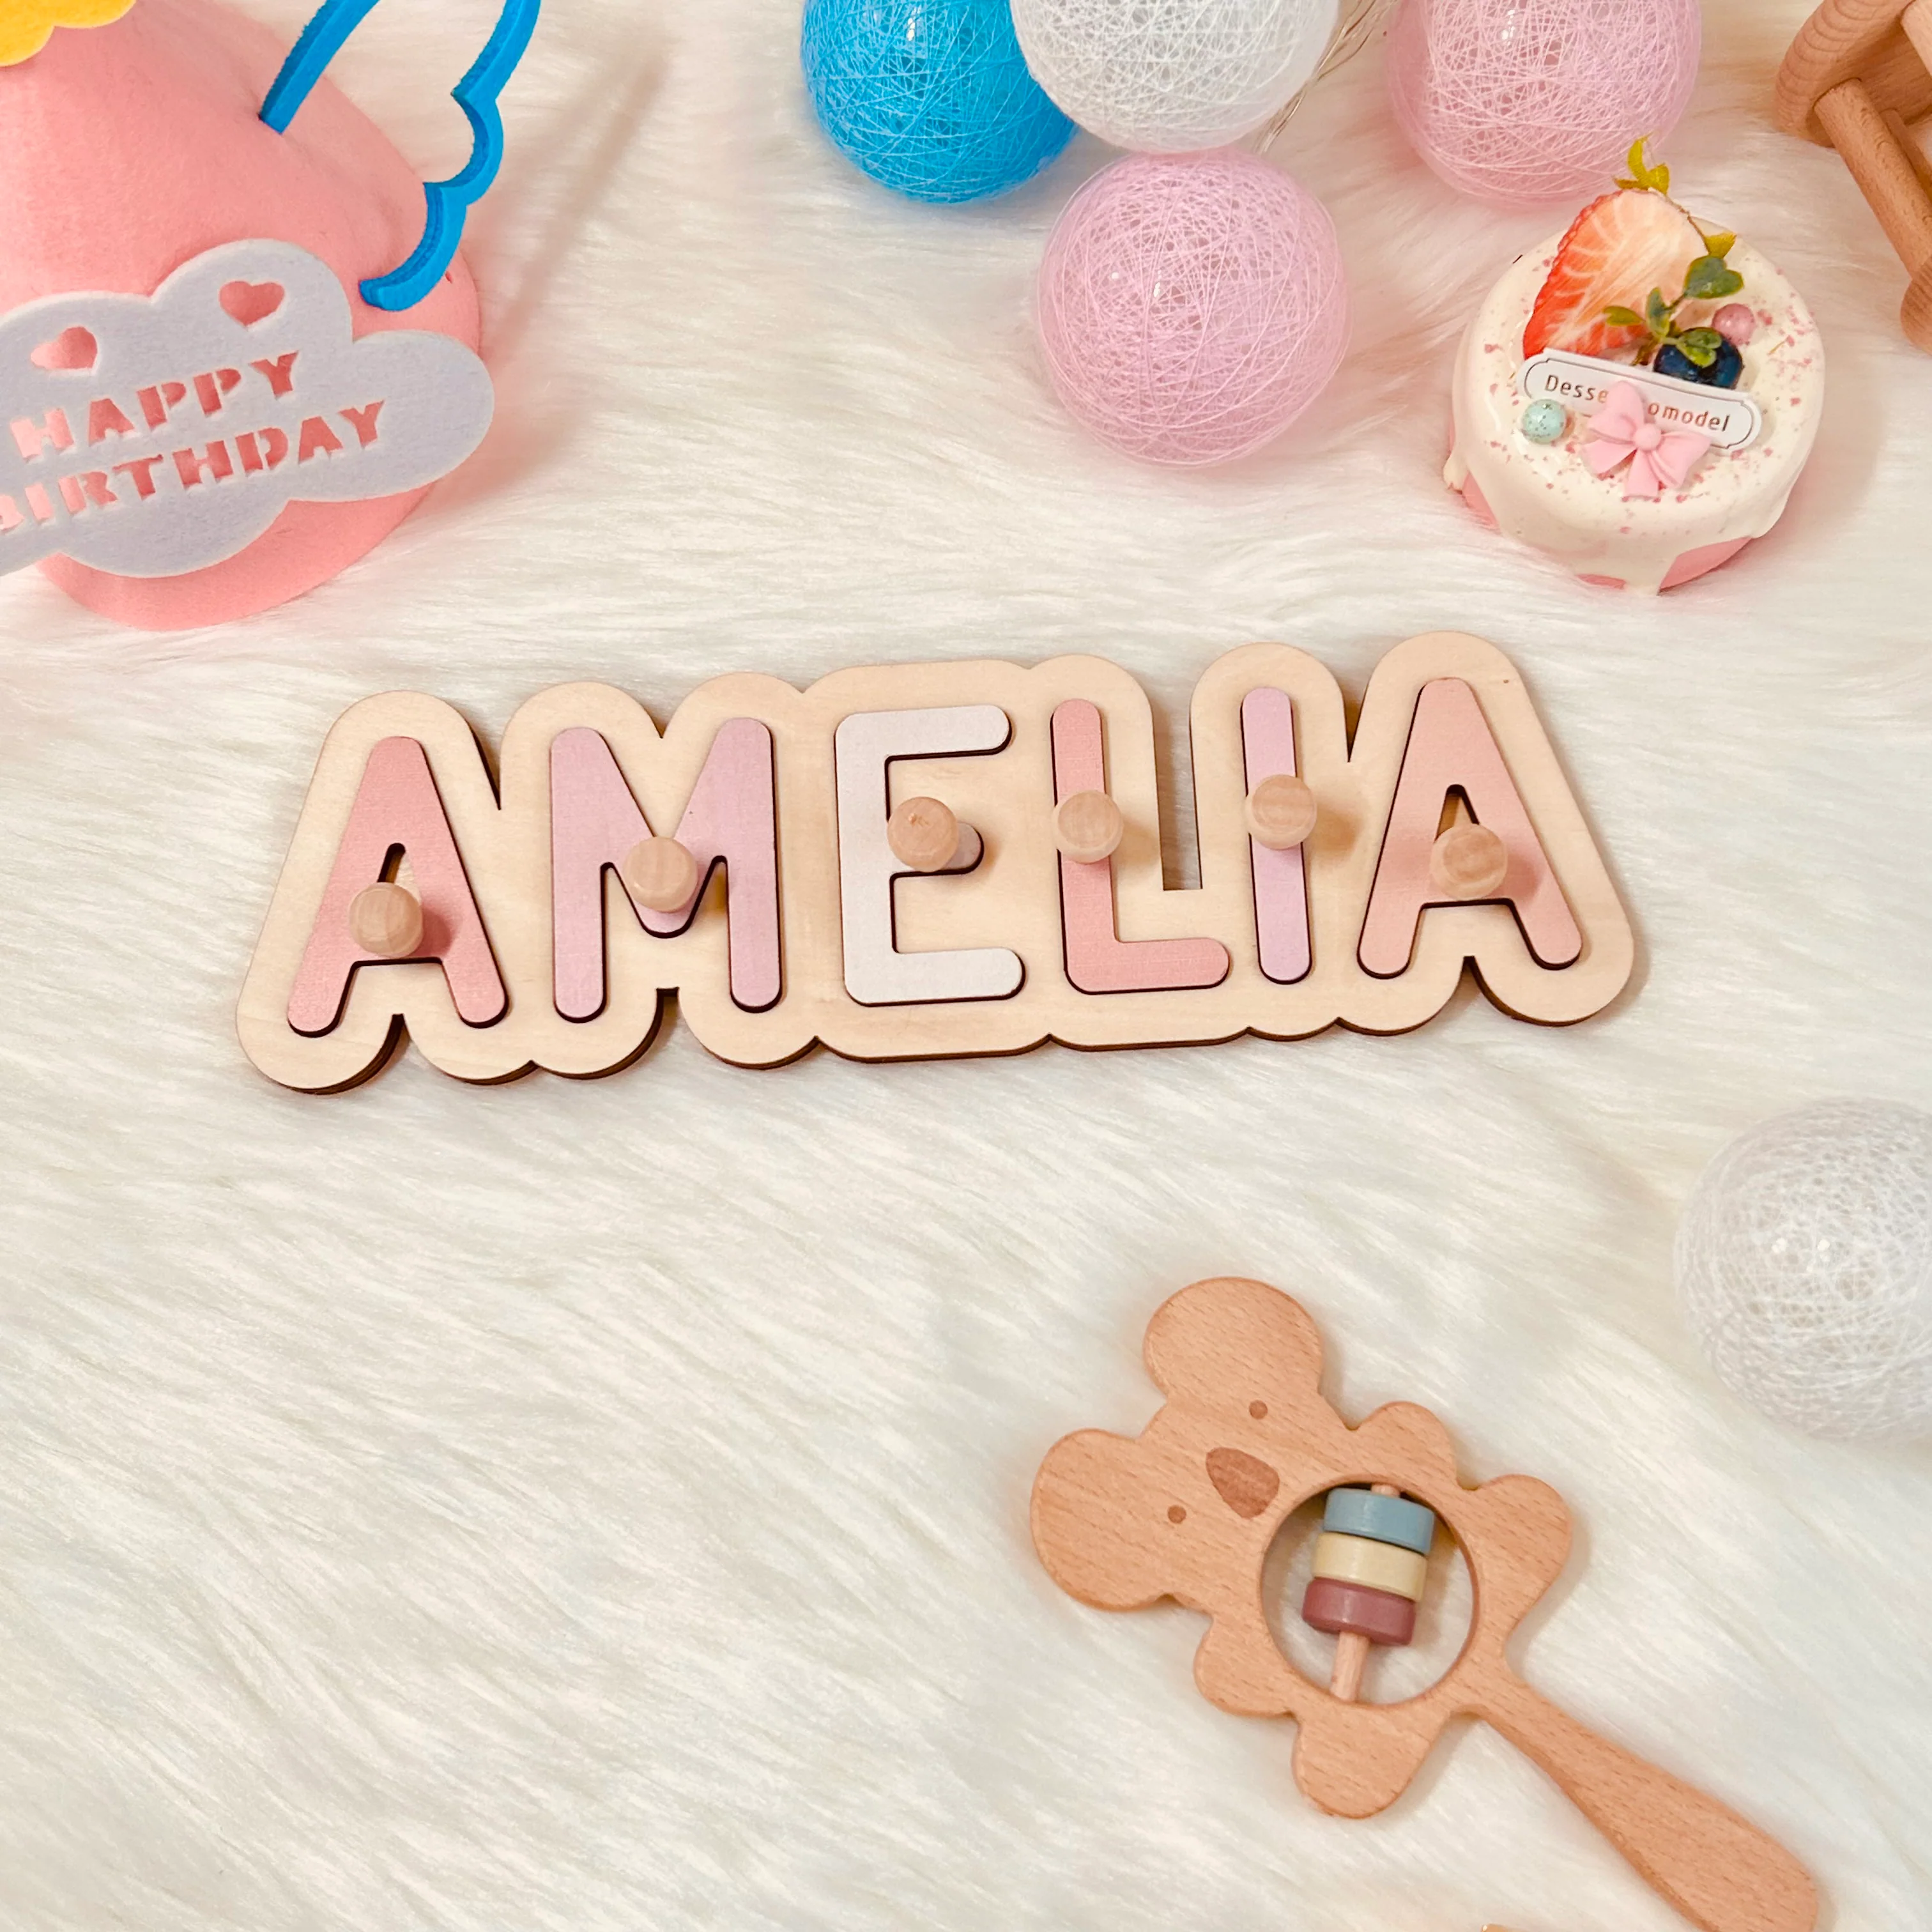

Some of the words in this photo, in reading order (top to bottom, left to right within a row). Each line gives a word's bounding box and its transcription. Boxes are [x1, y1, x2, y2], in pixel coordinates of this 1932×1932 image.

[10, 351, 299, 462] HAPPY
[1544, 374, 1609, 404] Desse
[288, 677, 1583, 1037] AMELIA
